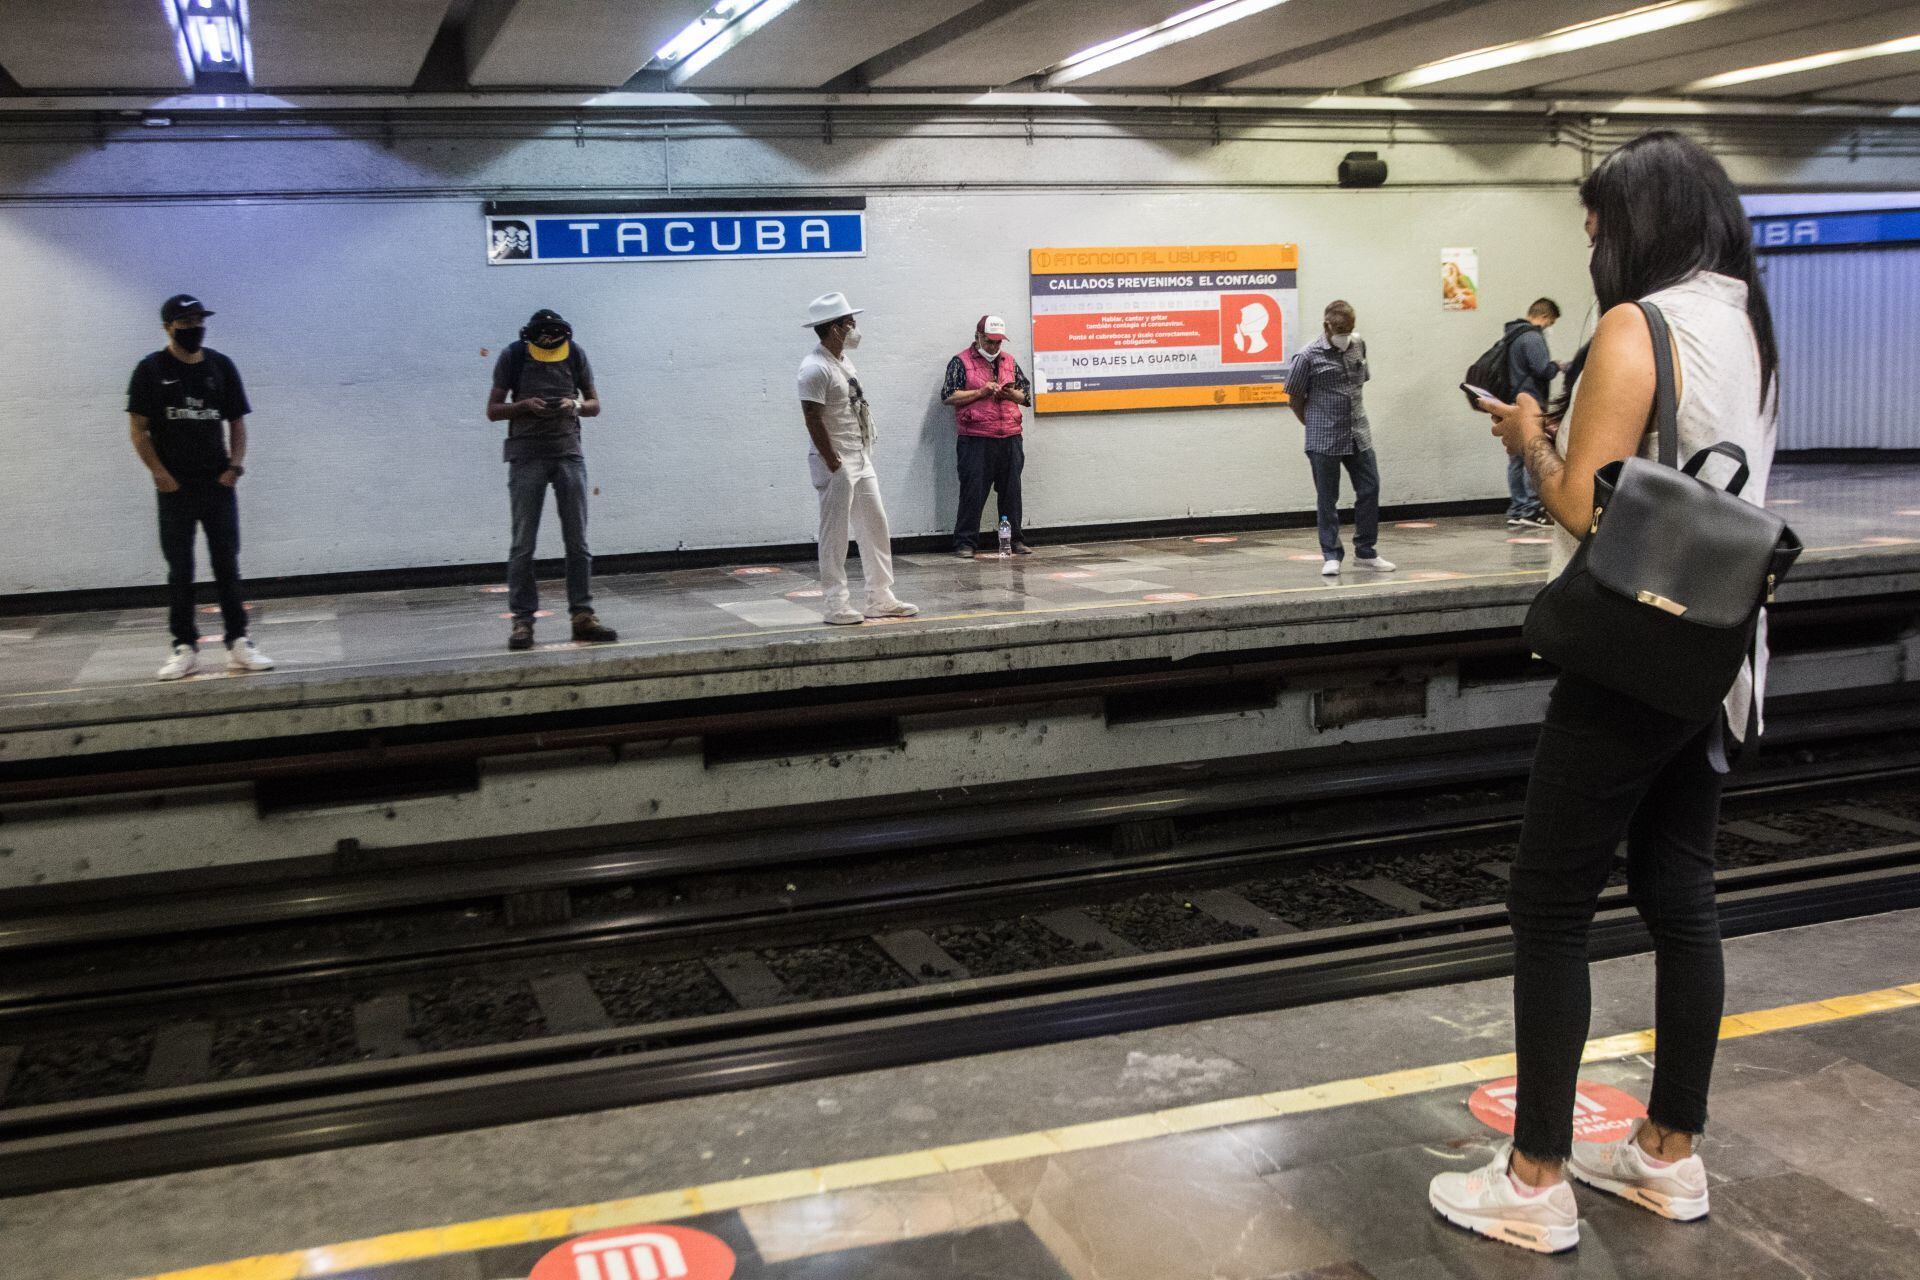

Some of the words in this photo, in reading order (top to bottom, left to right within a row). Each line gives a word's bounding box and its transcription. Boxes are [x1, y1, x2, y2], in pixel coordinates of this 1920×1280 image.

[568, 218, 831, 254] TACUBA
[1053, 252, 1139, 267] ATENCION
[1141, 252, 1164, 265] AL
[1168, 250, 1237, 264] USUARIO
[1049, 278, 1115, 290] CALLADOS
[1117, 276, 1194, 288] PREVENIMOS
[1199, 275, 1214, 286] EL
[1216, 274, 1277, 286] CONTAGIO
[1072, 357, 1089, 367] NO
[1092, 356, 1127, 366] BAJES
[1130, 355, 1144, 364] LA
[1147, 353, 1198, 364] GUARDIA
